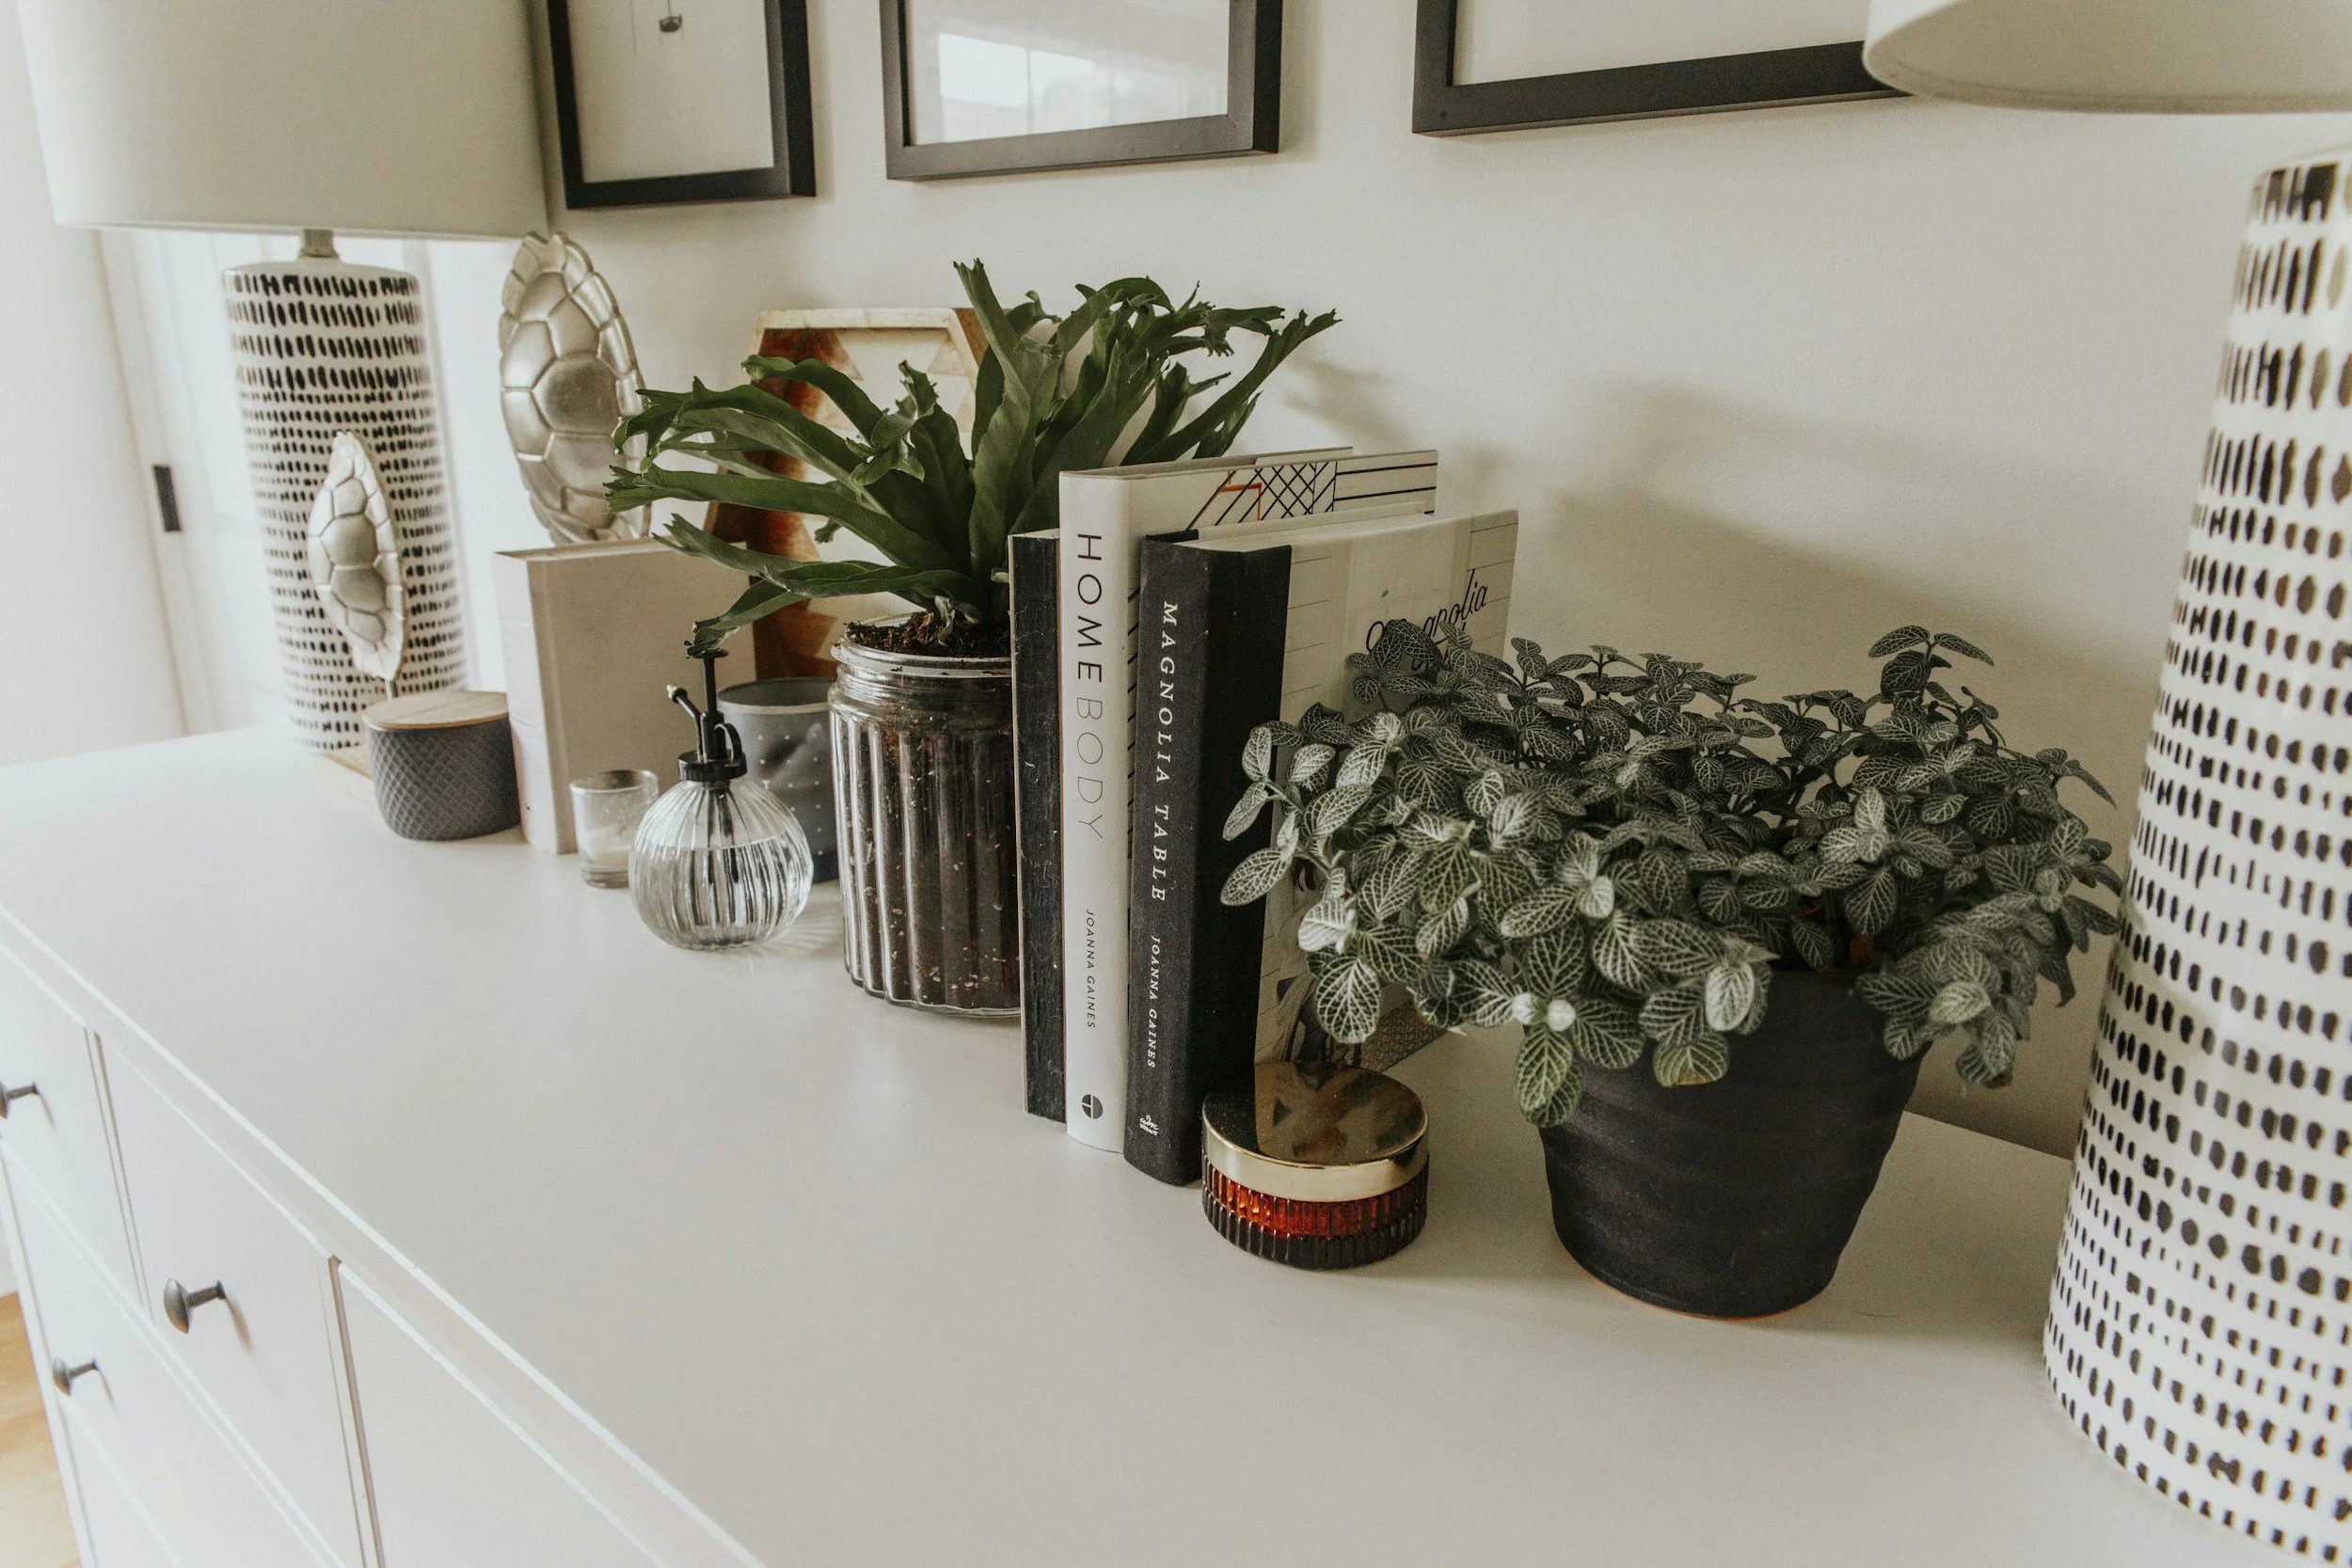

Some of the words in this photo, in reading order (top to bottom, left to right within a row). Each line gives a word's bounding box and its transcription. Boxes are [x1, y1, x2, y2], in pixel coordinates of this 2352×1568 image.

[1156, 600, 1178, 783] MAGNOLIA
[1152, 804, 1169, 901] TABLE
[1086, 909, 1095, 969] JOANNA
[1149, 935, 1161, 1000] JOANNA
[1087, 975, 1096, 1028] GAINES
[1147, 1008, 1158, 1069] GAINES
